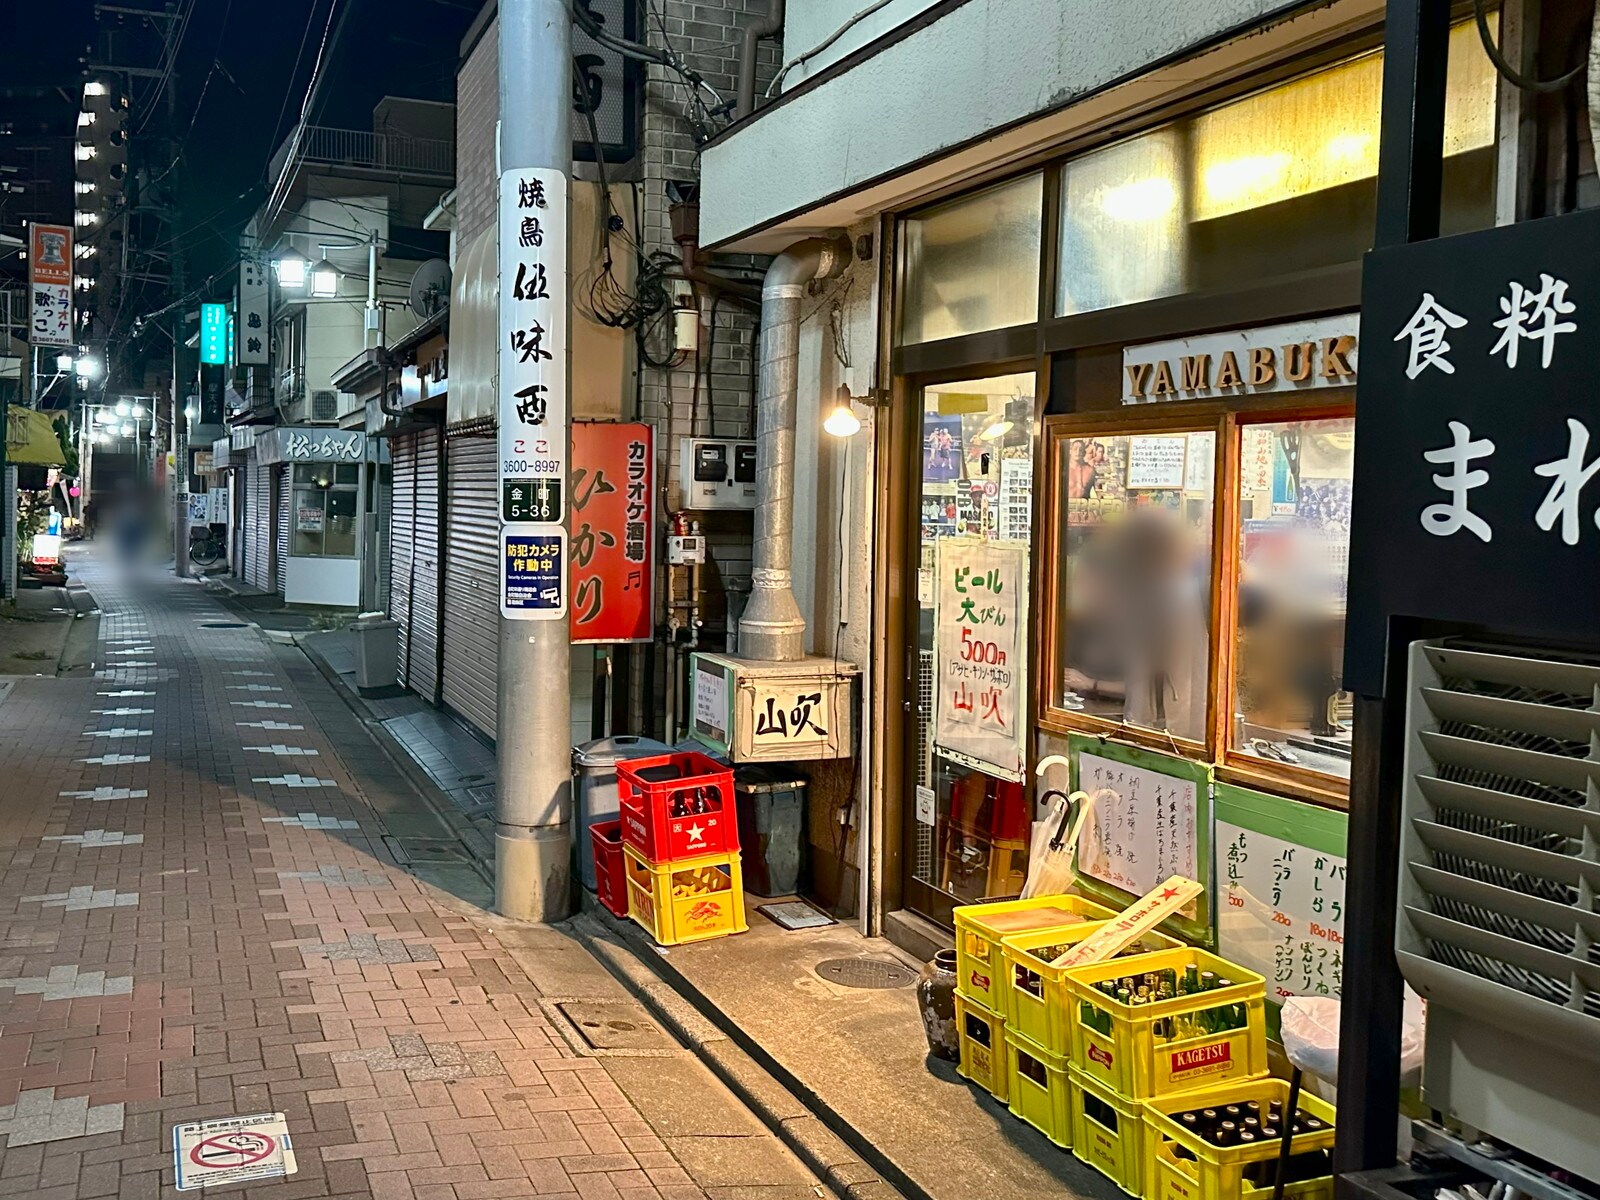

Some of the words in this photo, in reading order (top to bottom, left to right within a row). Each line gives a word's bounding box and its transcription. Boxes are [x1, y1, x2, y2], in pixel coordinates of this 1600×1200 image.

[34, 291, 54, 332] 歌っこ
[57, 288, 70, 331] カラオケ
[286, 432, 363, 459] 松っちゃん
[513, 439, 548, 454] ここ
[503, 461, 560, 473] 3600-8997
[511, 488, 550, 501] 金町
[624, 441, 645, 562] カラオケ酒場
[512, 505, 550, 518] 5-36
[507, 544, 560, 557] 防犯カメラ
[571, 468, 616, 624] ひかり
[513, 559, 553, 572] 作動中
[954, 566, 1003, 594] ビール
[955, 597, 1006, 626] 大びん
[960, 626, 1006, 666] 500円
[756, 693, 828, 738] 山吹
[953, 682, 1006, 728] 山吹
[708, 819, 717, 827] 20
[1238, 833, 1248, 863] もつ
[1227, 843, 1244, 890] 煮込み
[1282, 848, 1296, 880] バラ
[1272, 859, 1282, 907] ニンニク
[1312, 857, 1328, 913] かしら
[1228, 892, 1244, 908] 500
[1271, 910, 1292, 927] 280
[1310, 922, 1326, 938] 180
[1300, 942, 1314, 990] ぼんじり
[1314, 947, 1330, 995] つくね
[1177, 1044, 1226, 1067] KAGETSU
